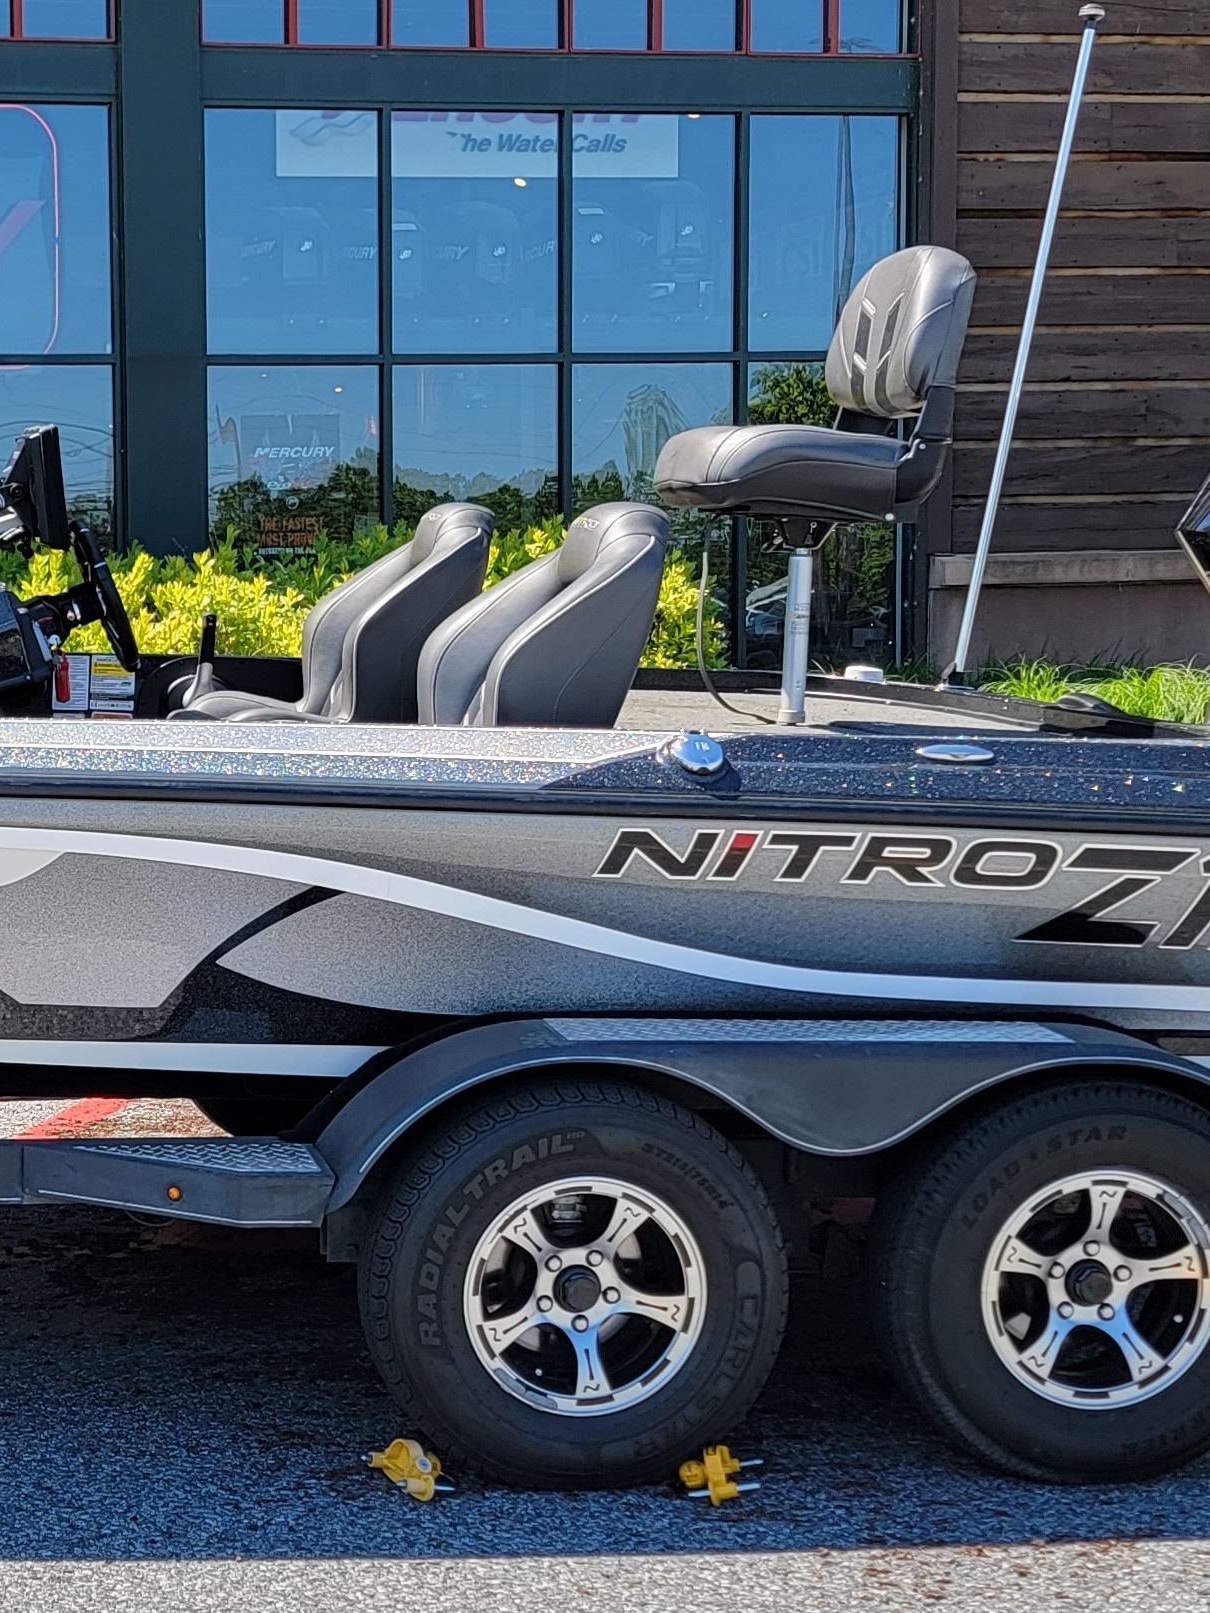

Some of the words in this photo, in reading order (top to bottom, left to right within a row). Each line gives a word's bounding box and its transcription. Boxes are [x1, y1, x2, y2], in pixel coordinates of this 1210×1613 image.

[497, 133, 560, 153] Wate
[571, 132, 628, 154] Calls
[253, 446, 335, 459] MERCURY
[591, 828, 1063, 890] NITRO
[1011, 843, 1210, 950] Z1
[961, 1160, 1021, 1230] LOAD
[1047, 1125, 1128, 1153] STAR
[417, 1202, 471, 1346] RADIAL
[462, 1134, 574, 1200] TRAIL
